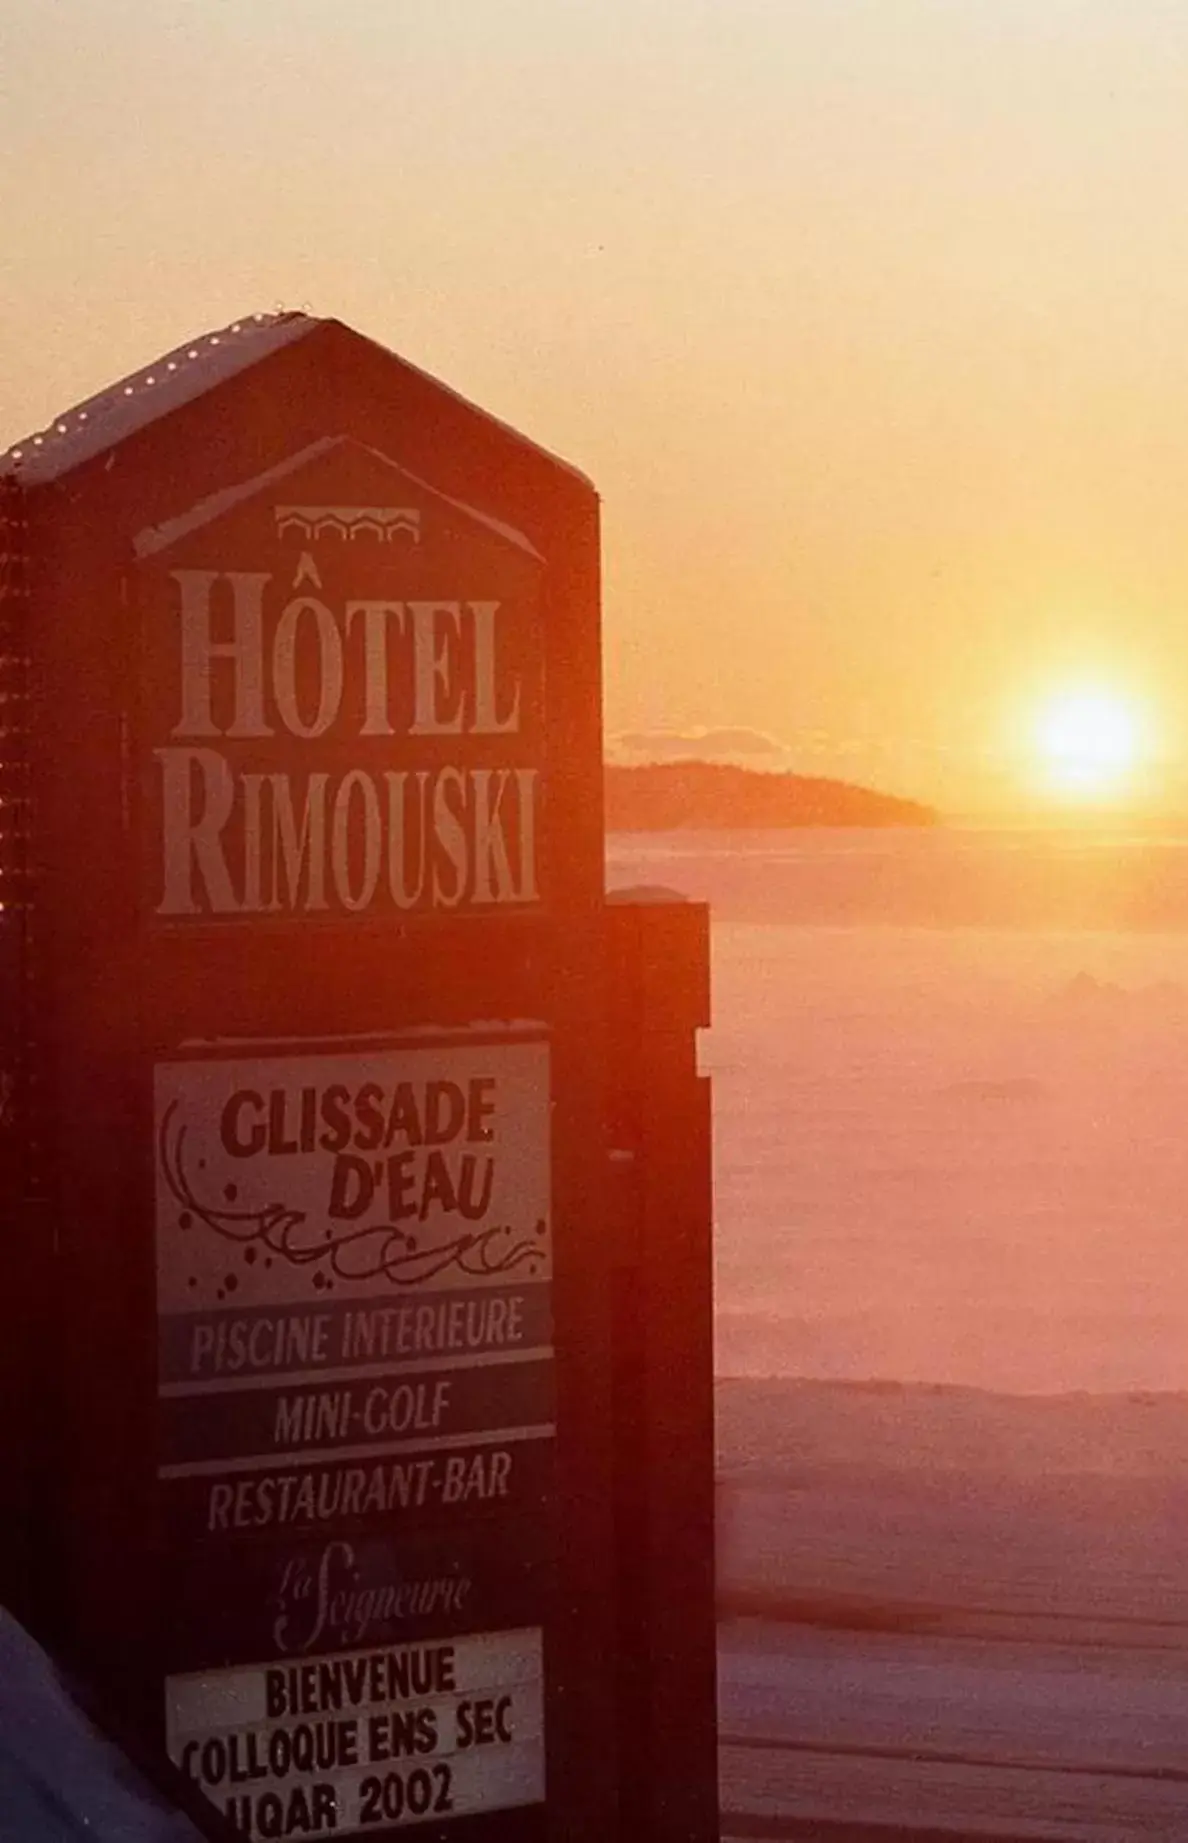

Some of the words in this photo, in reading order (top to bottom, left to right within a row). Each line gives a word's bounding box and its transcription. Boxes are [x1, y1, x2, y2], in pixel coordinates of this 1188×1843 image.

[169, 551, 522, 738] HÔTEL
[152, 746, 541, 914] RIMOUSKI
[219, 1077, 496, 1158] GLISSADE
[327, 1150, 495, 1221] D'EAU
[189, 1313, 333, 1373] PISCINE
[274, 1381, 452, 1443] MINI-GOLF
[207, 1452, 512, 1531] RESTAURANT-BAR
[265, 1646, 456, 1718] BIENVENUE
[182, 1720, 358, 1786] COLLOQUE
[368, 1708, 437, 1762] ENS
[456, 1697, 513, 1749] SEC
[358, 1763, 453, 1824] 2002
